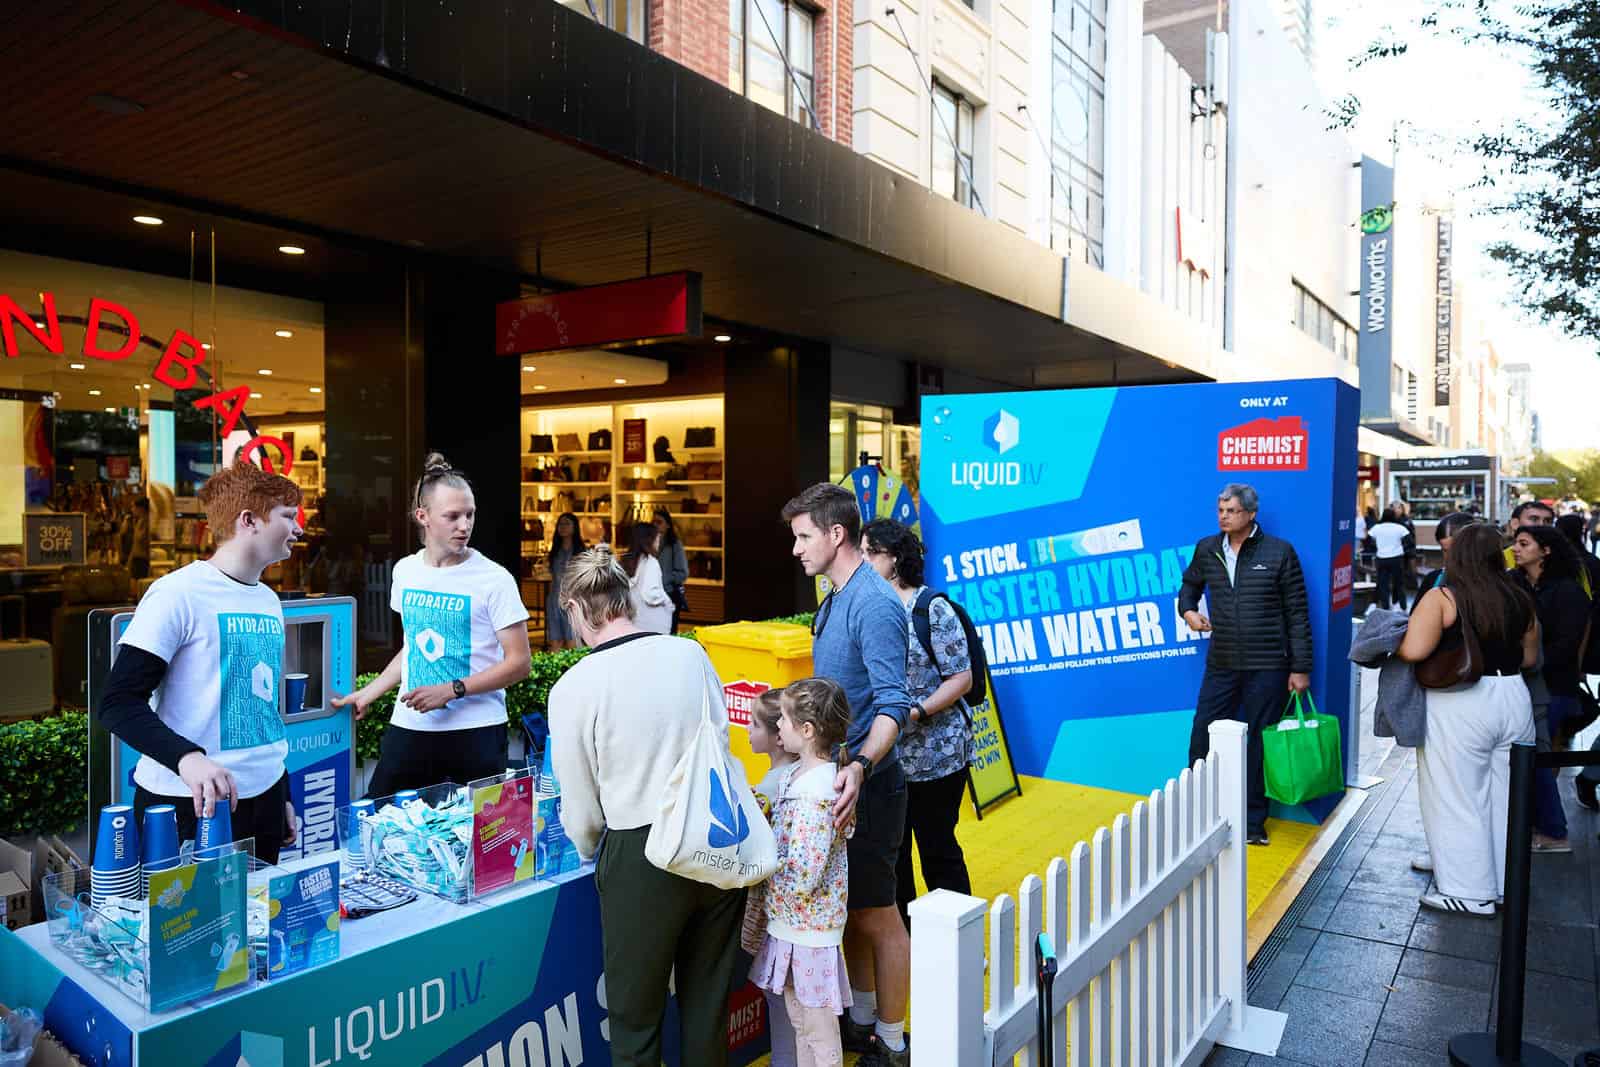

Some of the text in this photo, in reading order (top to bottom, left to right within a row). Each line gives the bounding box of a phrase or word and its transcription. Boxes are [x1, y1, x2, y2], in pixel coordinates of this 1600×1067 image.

[1240, 396, 1288, 408] ONLY AT
[1222, 436, 1304, 454] CHEMIST
[1222, 455, 1300, 465] WAREHOUSE
[951, 462, 1020, 491] LIQUID
[39, 526, 73, 538] 30%
[39, 538, 73, 551] OFF
[943, 543, 1027, 582] 1 STICK.
[1067, 543, 1197, 608] HYDRAT
[399, 591, 465, 612] HYDRATED
[1042, 602, 1166, 658] WATER
[1012, 667, 1025, 675] THE
[1065, 658, 1096, 670] FOLLOW
[1096, 656, 1112, 665] THE
[1113, 650, 1161, 663] DIRECTIONS
[1162, 649, 1179, 658] FOR
[1180, 646, 1198, 656] USE
[972, 717, 990, 733] OUR
[289, 733, 329, 752] LIQUID
[113, 830, 125, 851] LIQUID
[692, 849, 765, 876] mister zimi
[299, 867, 331, 890] FASTER
[308, 977, 447, 1067] LIQUID
[729, 996, 763, 1033] MIST
